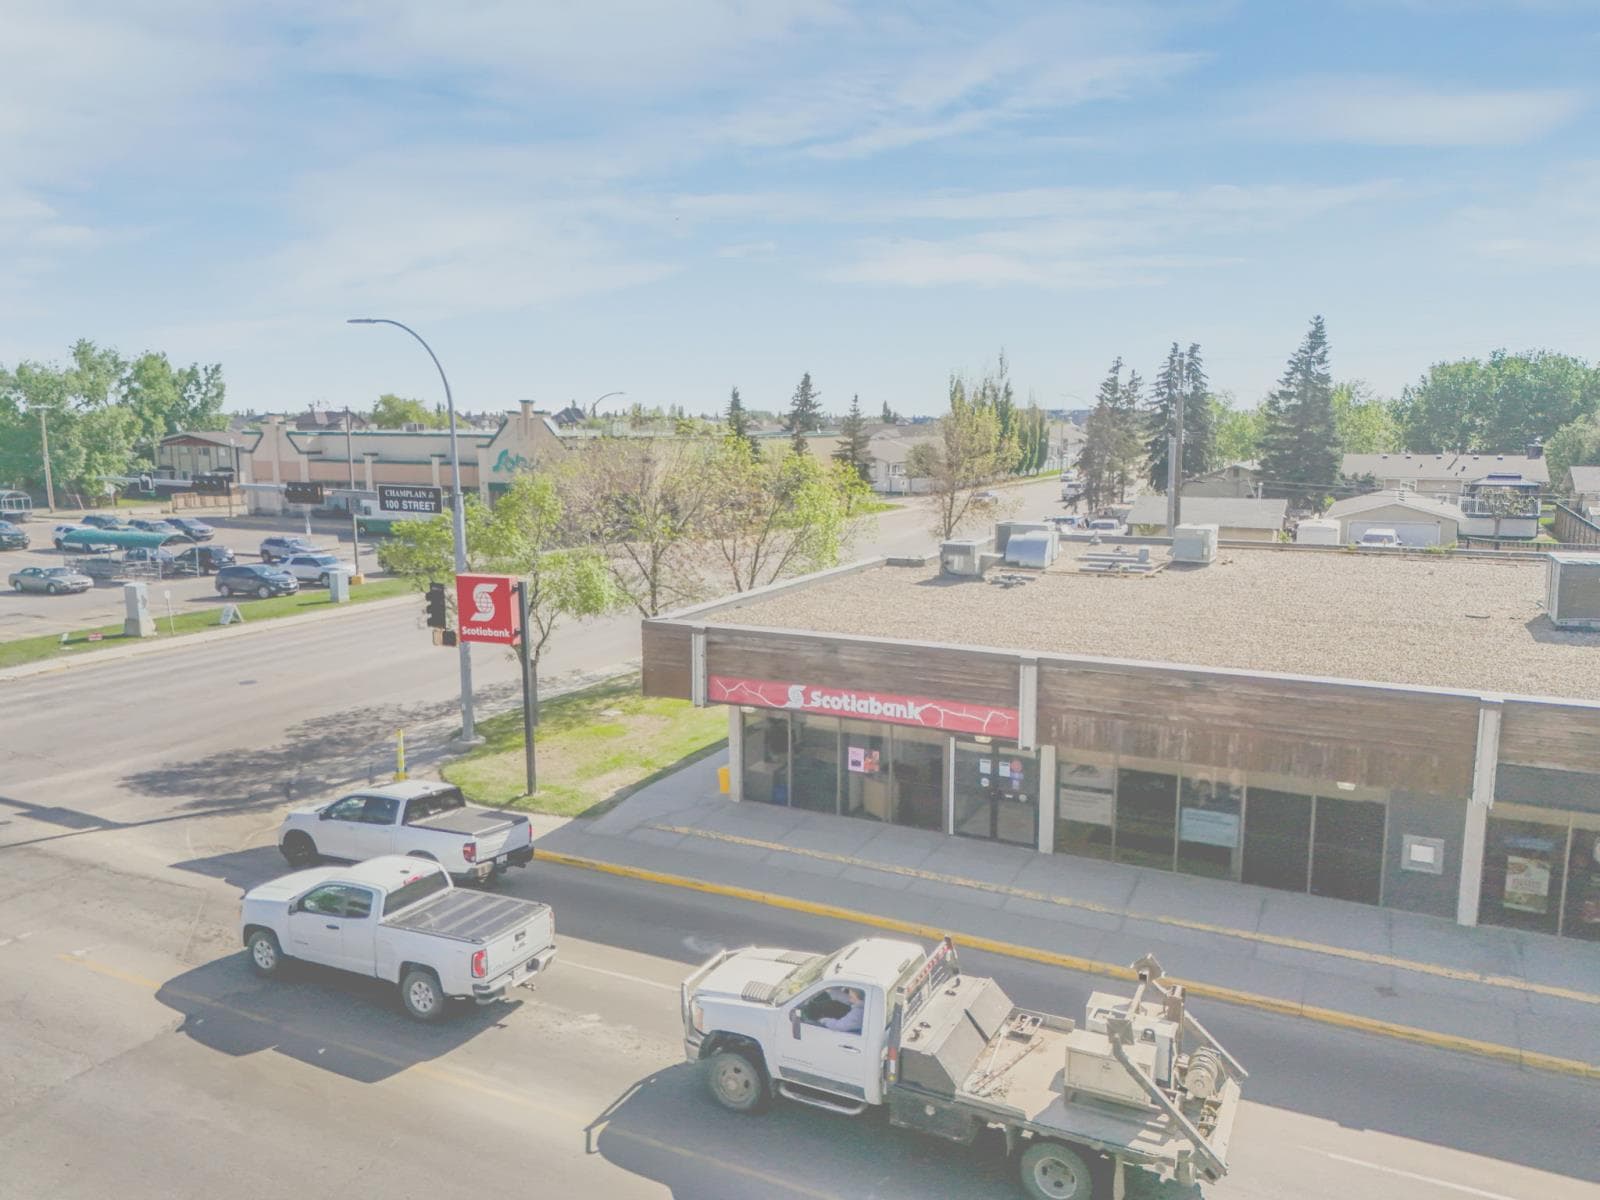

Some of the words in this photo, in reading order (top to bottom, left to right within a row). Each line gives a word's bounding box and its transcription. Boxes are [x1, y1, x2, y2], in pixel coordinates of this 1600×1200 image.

[385, 489, 426, 498] CHAMPLAIN
[385, 500, 399, 510] 100
[402, 500, 435, 511] STREET
[462, 626, 510, 637] Scotiabank
[811, 691, 920, 720] Scotiabank
